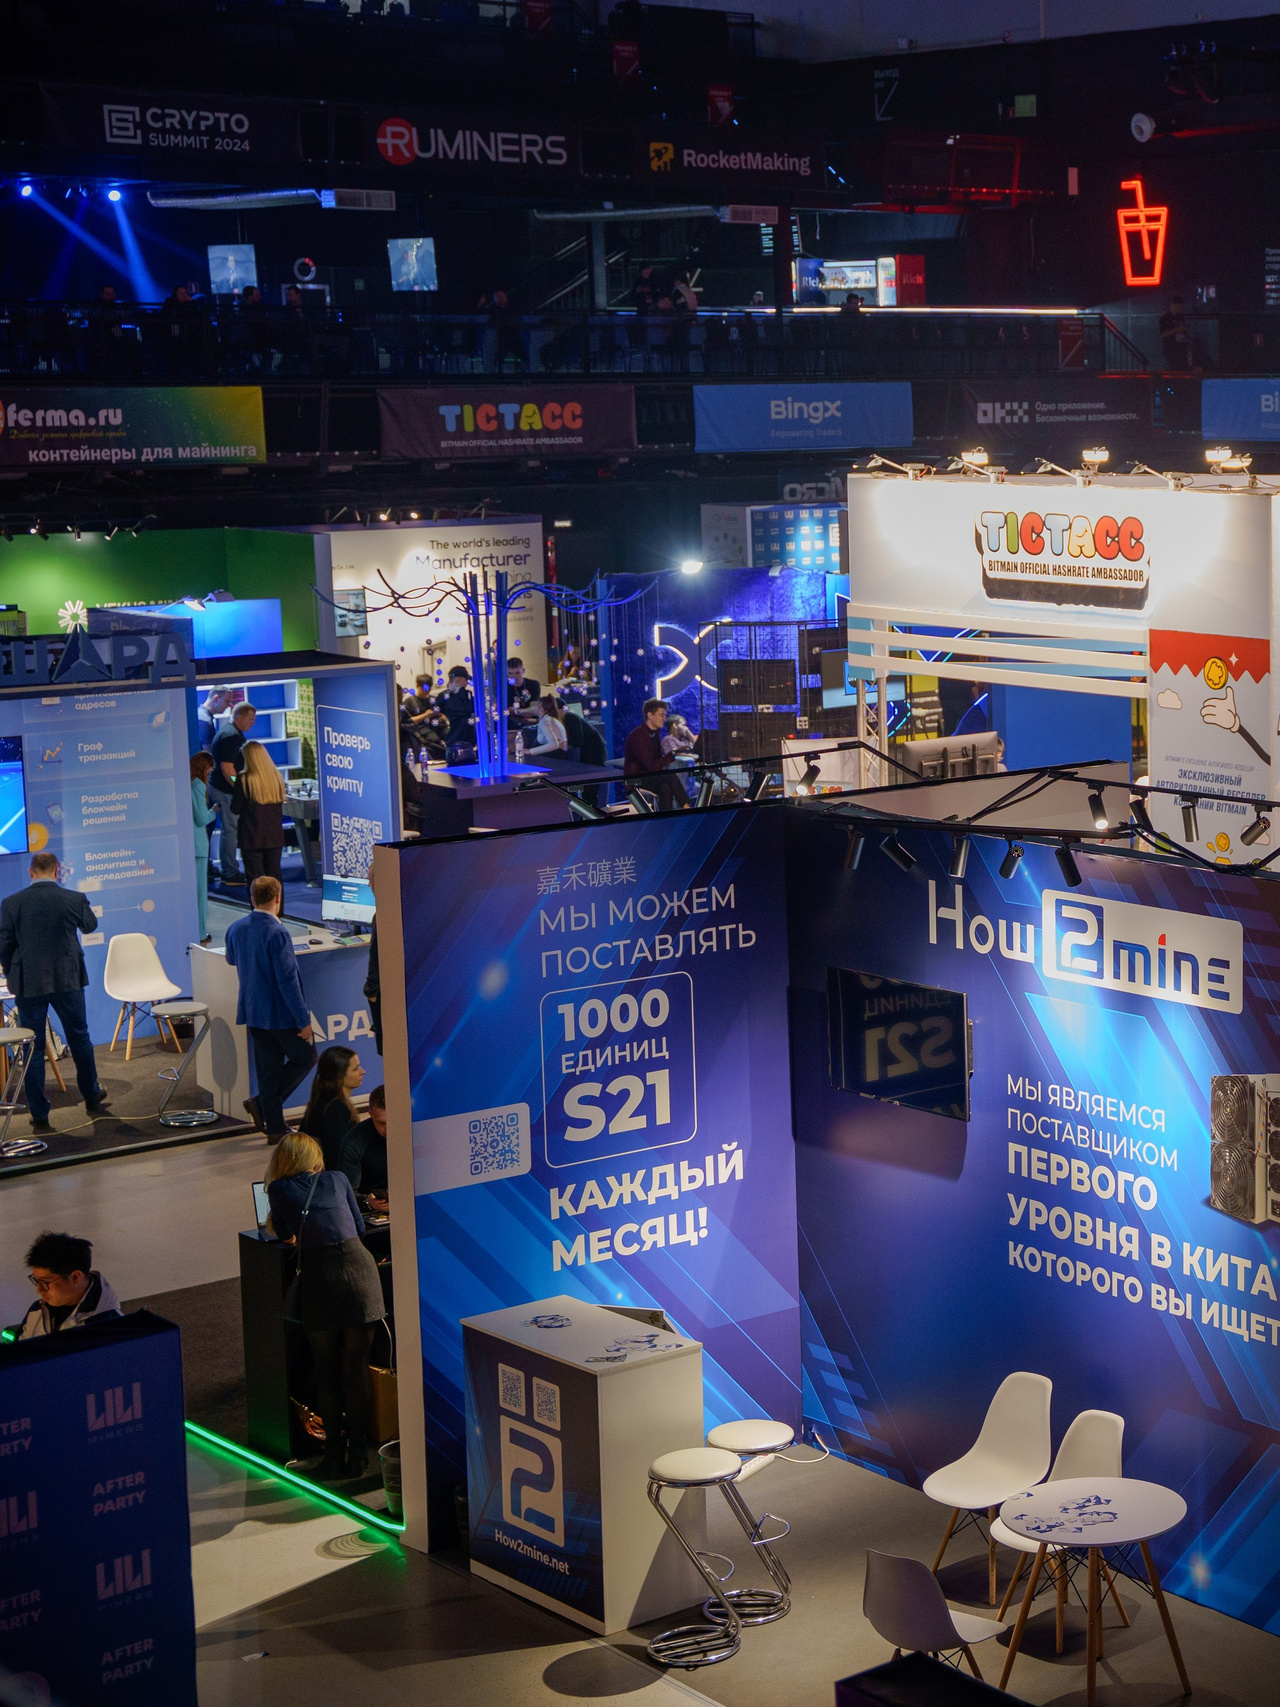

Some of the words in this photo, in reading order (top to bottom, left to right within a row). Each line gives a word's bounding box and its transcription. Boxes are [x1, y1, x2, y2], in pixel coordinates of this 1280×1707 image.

[145, 105, 250, 136] CRYPTO
[149, 132, 209, 150] SUMMIT
[214, 136, 251, 153] 2024
[384, 124, 568, 166] RUMINERS
[683, 149, 811, 176] RocketMaking
[439, 401, 584, 433] TICTACC
[977, 401, 1029, 424] OKX
[28, 444, 137, 464] контейнеры
[141, 447, 174, 463] для
[177, 443, 257, 459] майнинга
[429, 540, 450, 550] The
[451, 538, 491, 550] world's
[492, 536, 531, 550] leading
[980, 510, 1146, 563] TICTACC
[415, 553, 532, 570] Manufacturer
[988, 559, 1019, 574] BITMAIN
[1020, 562, 1051, 576] OFFICIAL
[1052, 564, 1090, 579] HASHRATE
[1091, 567, 1145, 582] AMBASSADOR
[75, 701, 117, 711] адресов
[78, 742, 104, 752] Граф
[324, 727, 372, 753] Проверь
[79, 749, 136, 763] транзакций
[325, 753, 354, 771] свою
[327, 775, 365, 798] крипту
[1178, 768, 1242, 787] ЭКСКЛЮЗИВНЫЙ
[81, 791, 139, 805] Разработка
[82, 804, 128, 815] блокчейн
[1216, 801, 1244, 816] BITMAIN
[83, 814, 127, 827] решений
[85, 849, 136, 862] Блокчейн-
[86, 859, 137, 873] аналитика
[87, 868, 155, 883] исследования
[535, 856, 638, 897] 嘉禾礦業
[539, 903, 597, 936] МЫ
[609, 884, 736, 926] МОЖЕМ
[541, 922, 757, 978] ПОСТАВЛЯТЬ
[557, 988, 670, 1042] 1000
[561, 1037, 669, 1076] ЕДИНИЦ
[562, 1069, 671, 1142] S21
[1007, 1073, 1042, 1103] МЫ
[1048, 1084, 1166, 1133] ЯВЛЯЕМСЯ
[1007, 1107, 1179, 1172] ПОСТАВЩИКОМ
[549, 1141, 745, 1221] КАЖДЫЙ
[1007, 1142, 1158, 1211] ПЕРВОГО
[551, 1206, 709, 1272] МЕСЯЦ!
[1006, 1193, 1139, 1262] УРОВНЯ
[1150, 1233, 1173, 1269] В
[1008, 1241, 1143, 1304] КОТОРОГО
[1150, 1282, 1192, 1320] ВЫ
[92, 1470, 146, 1498] AFTER
[93, 1490, 147, 1518] PARTY
[494, 1528, 571, 1577] How2mine.net
[101, 1637, 154, 1666] AFTER
[101, 1655, 155, 1686] PARTY
